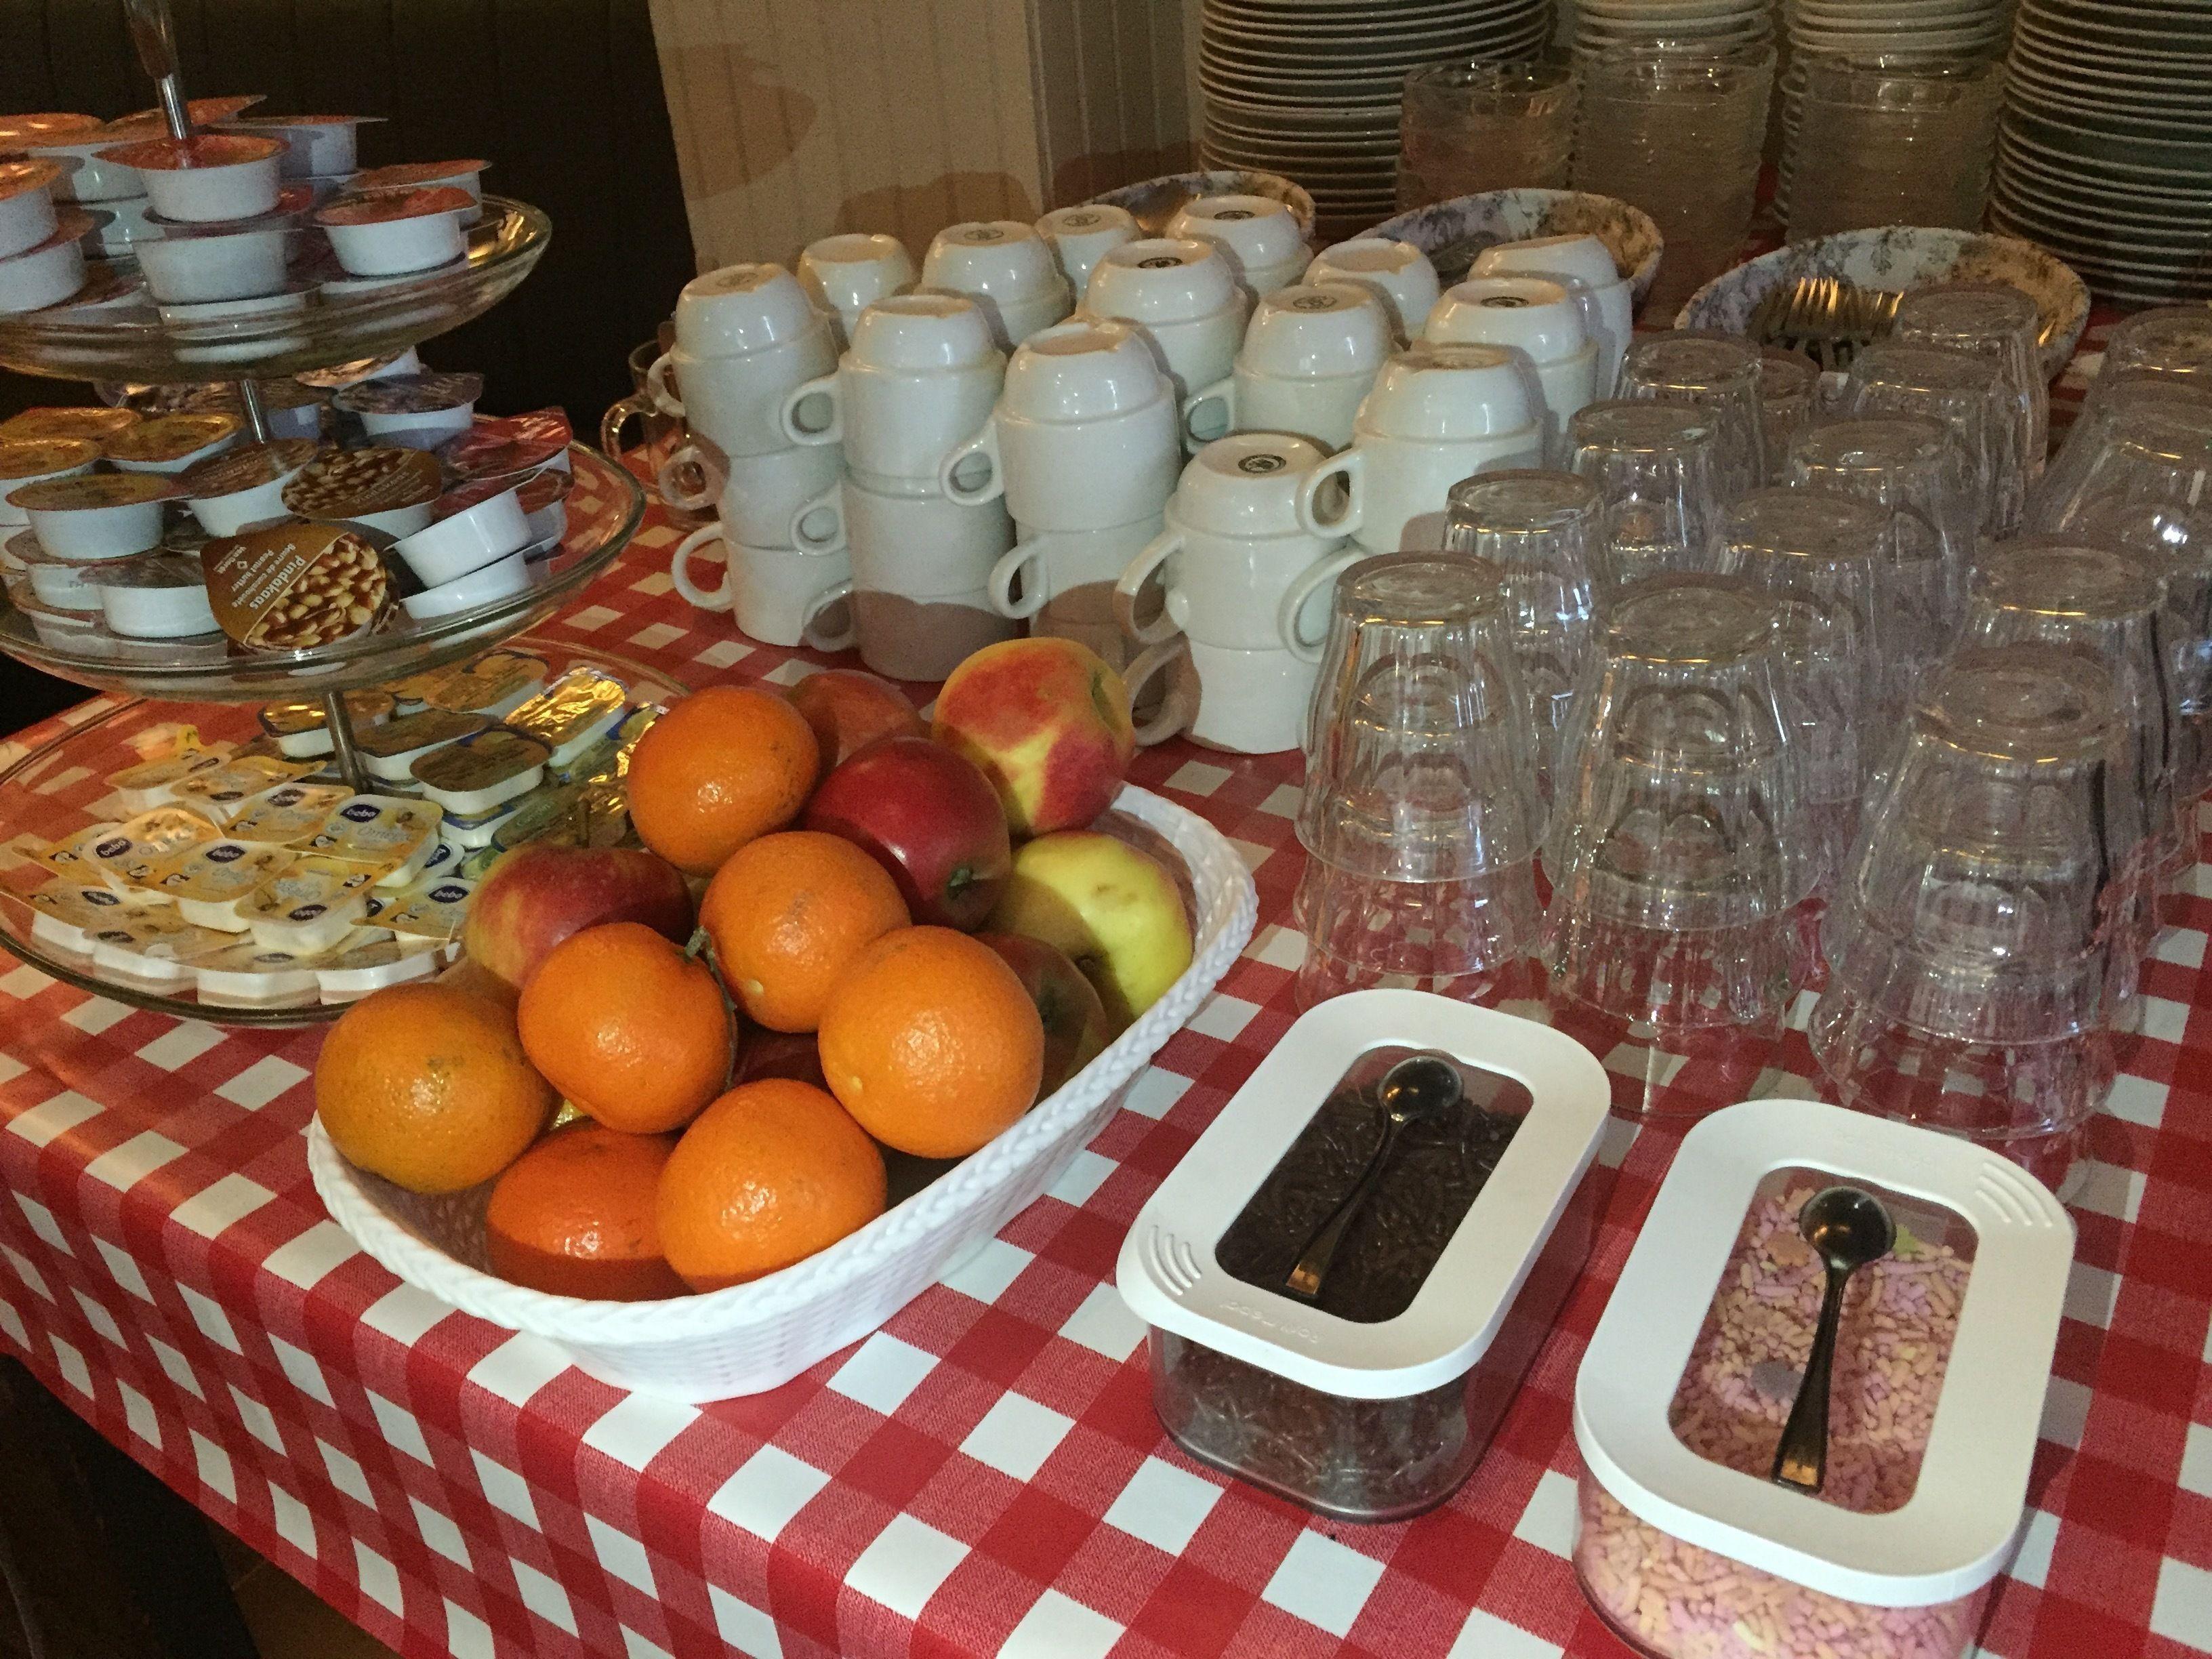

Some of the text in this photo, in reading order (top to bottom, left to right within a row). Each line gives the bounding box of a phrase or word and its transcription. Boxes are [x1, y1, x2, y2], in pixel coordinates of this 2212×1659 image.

[230, 548, 274, 593] Peanut butter
[266, 564, 275, 574] de
[273, 543, 296, 565] Beurre
[249, 554, 306, 609] Pindakaas
